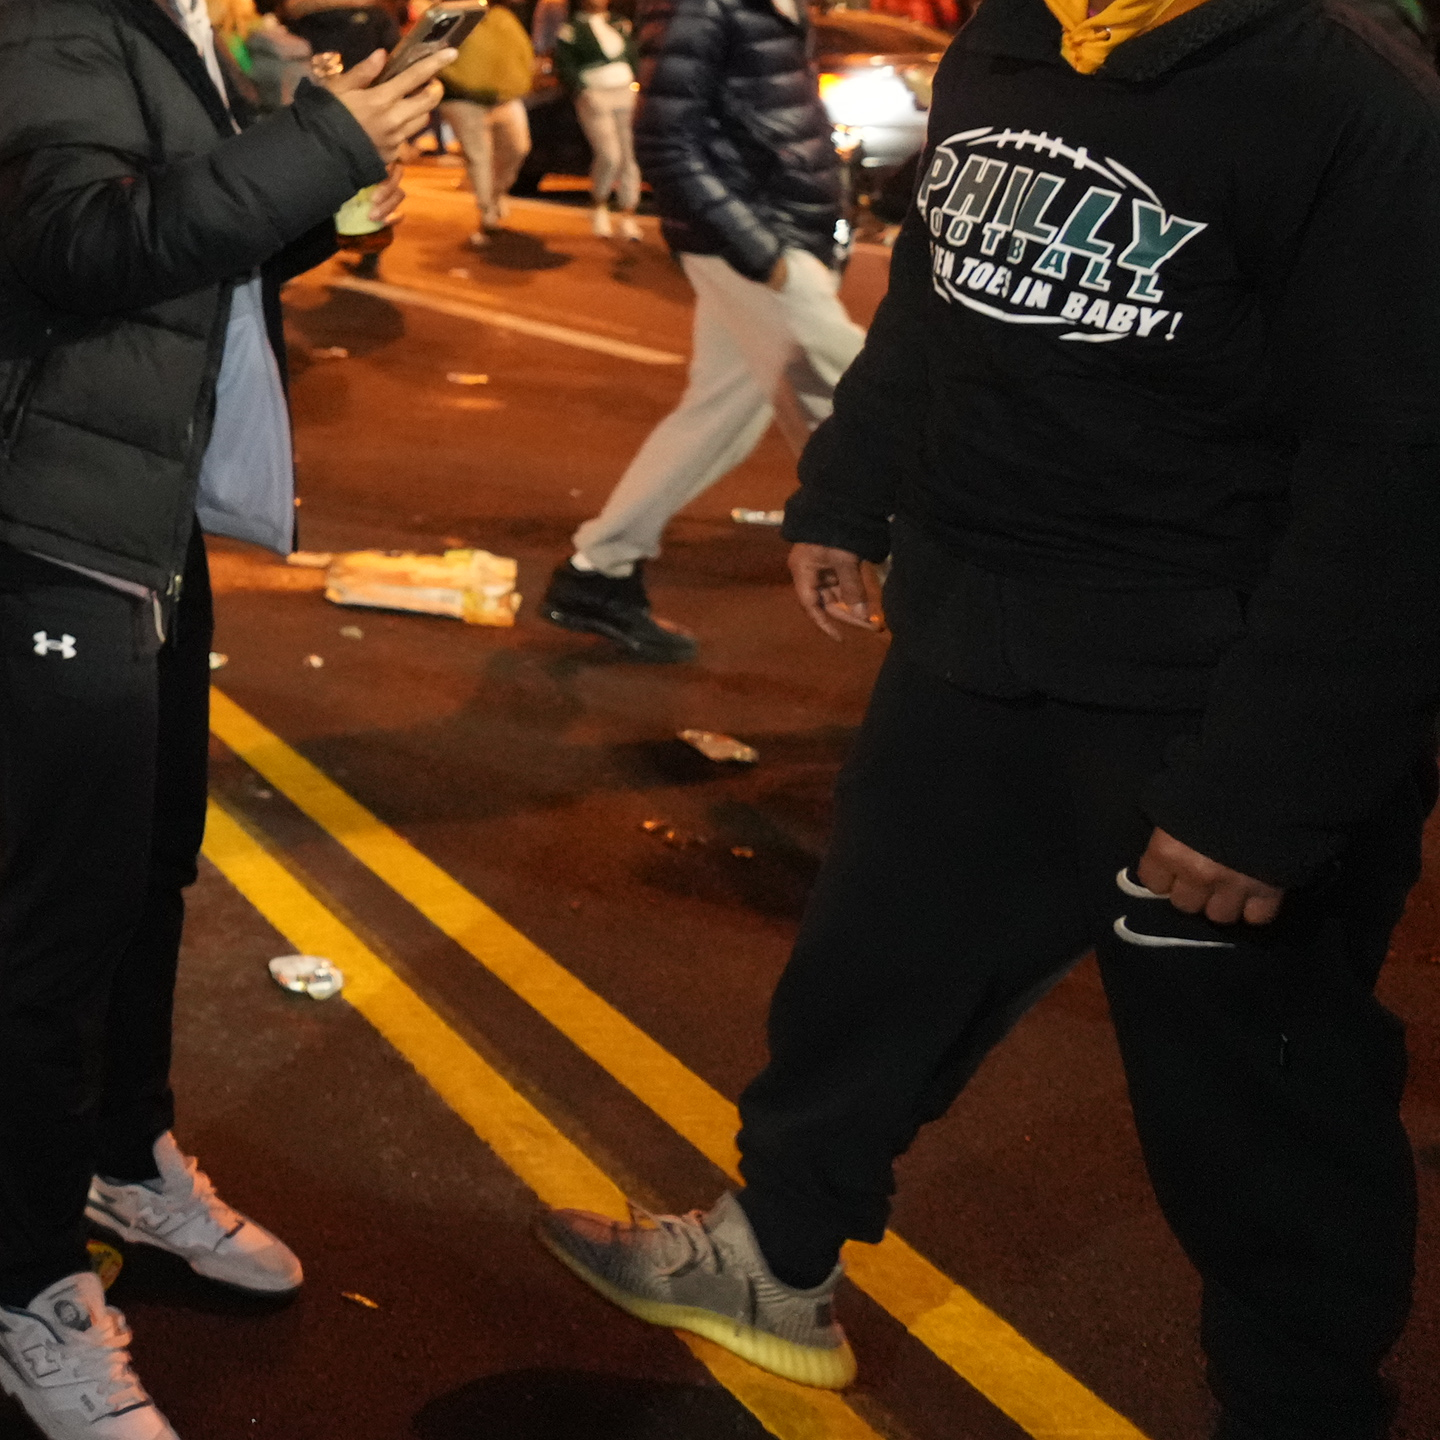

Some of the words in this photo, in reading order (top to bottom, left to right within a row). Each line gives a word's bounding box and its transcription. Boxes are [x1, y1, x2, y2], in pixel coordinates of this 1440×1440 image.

[917, 146, 1208, 273] PHILLY
[919, 205, 1164, 303] OOTBALL
[1009, 276, 1053, 310] IN
[1060, 291, 1183, 341] BABY!
